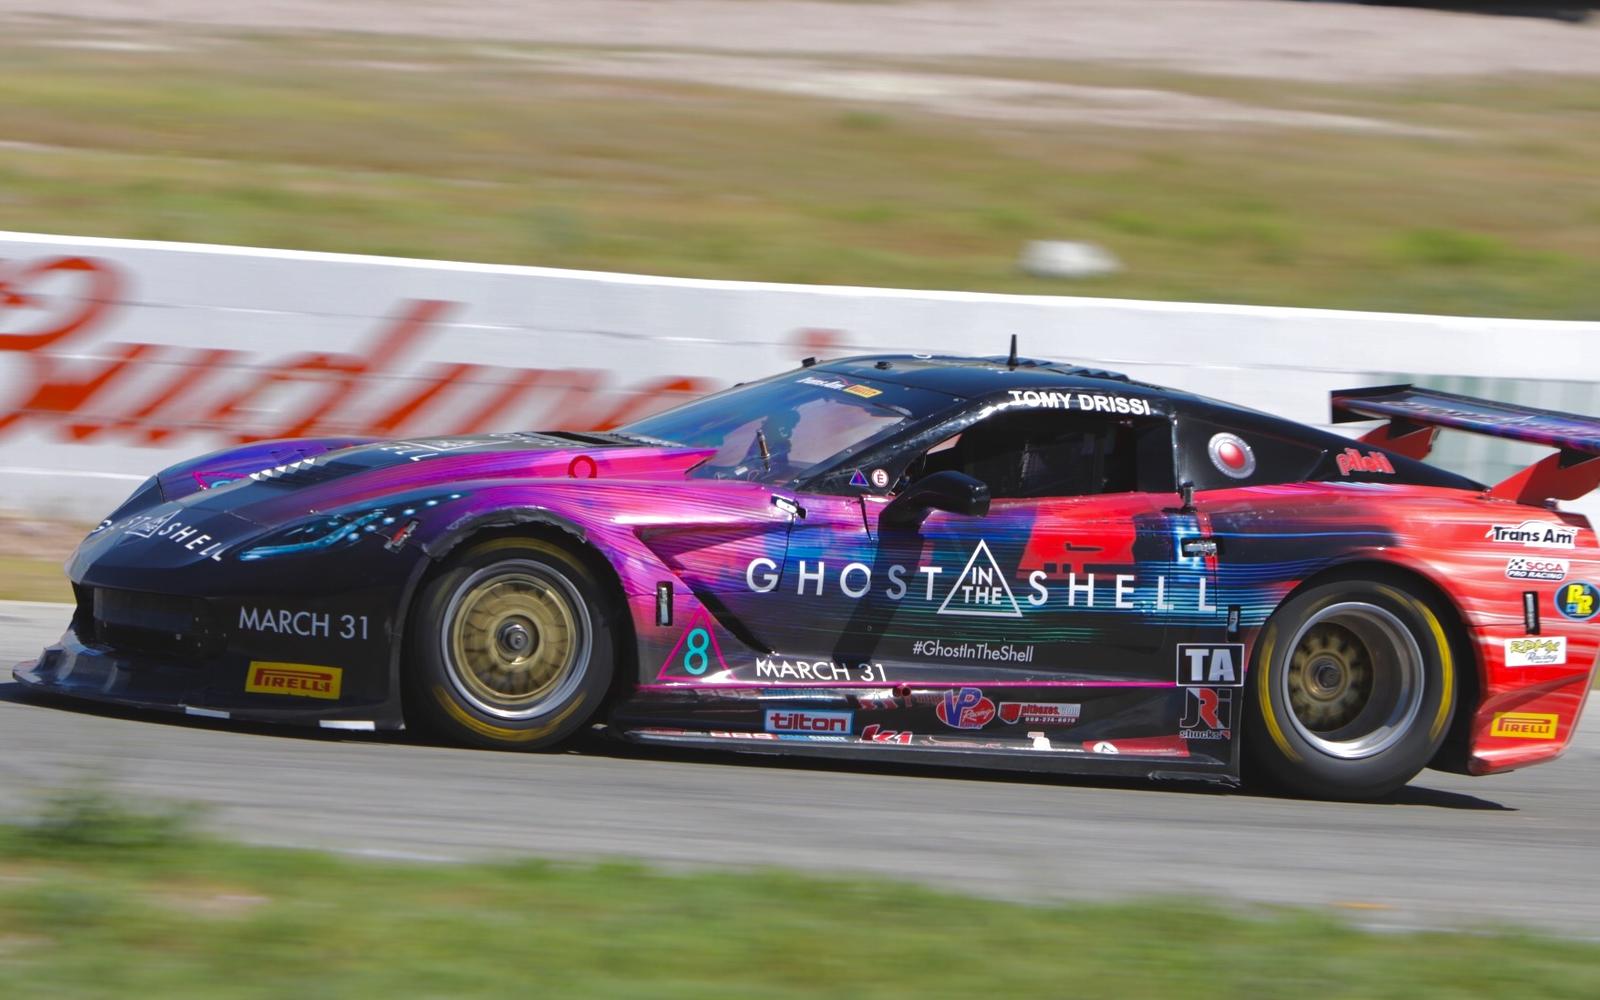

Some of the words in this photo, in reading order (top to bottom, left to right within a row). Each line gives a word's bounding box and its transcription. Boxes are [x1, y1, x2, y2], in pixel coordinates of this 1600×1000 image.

[1008, 390, 1071, 409] TOMY
[1077, 394, 1151, 416] DRISSI
[158, 522, 223, 562] SHELL
[1493, 526, 1540, 542] Trans
[1543, 528, 1572, 544] Am
[972, 566, 993, 587] IN
[1526, 561, 1563, 572] SCCA
[1528, 571, 1564, 580] RACING
[746, 558, 943, 601] GHOST
[1027, 570, 1217, 612] SHELL
[962, 585, 1002, 604] THE
[238, 606, 330, 637] MARCH
[339, 614, 368, 640] 31
[683, 627, 710, 675] 8
[913, 640, 1034, 663] #GhostInTheShell
[756, 657, 851, 681] MARCH
[859, 663, 887, 682] 31
[1185, 648, 1236, 681] TA
[253, 668, 333, 692] PIRELLI
[944, 687, 983, 728] VP
[770, 713, 847, 732] tilton
[1497, 717, 1553, 734] PIRELLI
